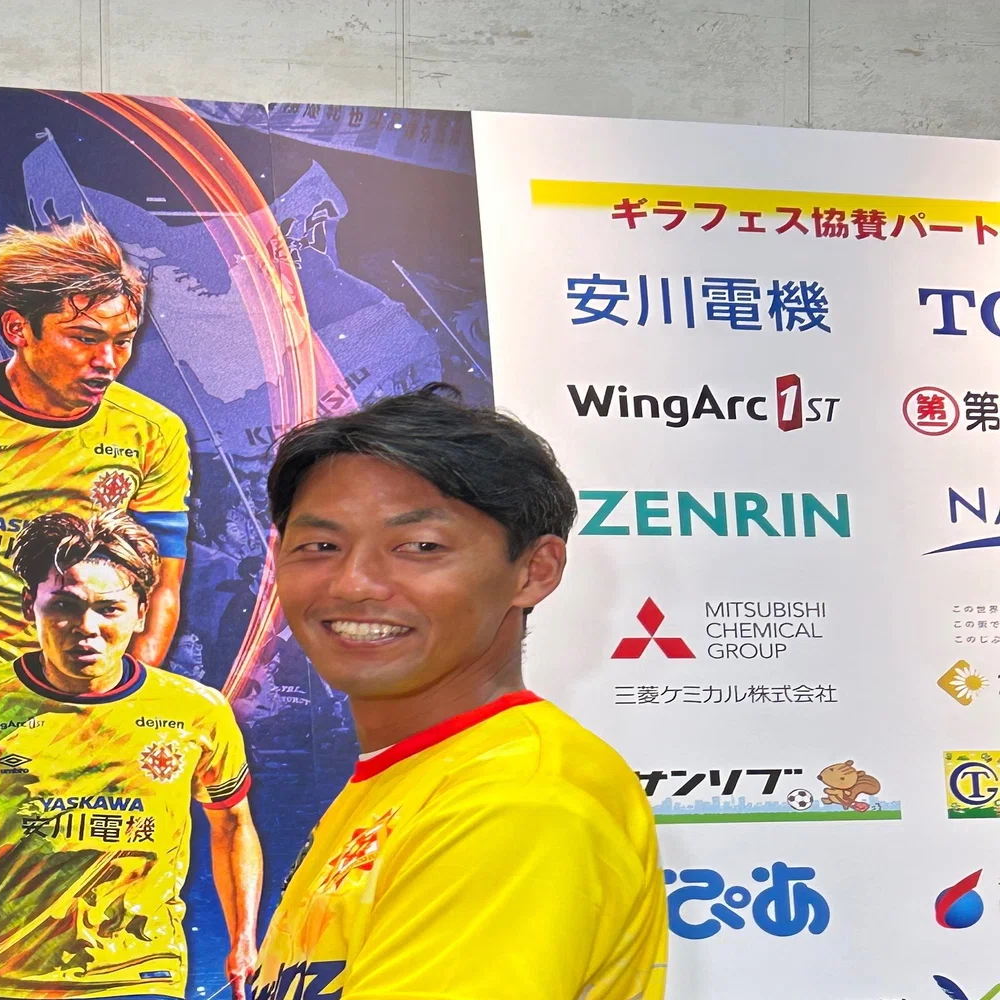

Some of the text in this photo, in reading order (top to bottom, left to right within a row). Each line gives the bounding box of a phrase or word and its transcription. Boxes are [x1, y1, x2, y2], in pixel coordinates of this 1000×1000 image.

[611, 198, 998, 245] ギラフェス協賛パート
[567, 274, 831, 333] 安川電機
[577, 491, 851, 538] ZENRIN
[948, 486, 1000, 525] N
[705, 602, 826, 619] MITSUBISHI
[705, 623, 823, 639] CHEMICAL
[707, 643, 788, 660] GROUP
[614, 684, 838, 705] 三菱ケミカル株式会社
[135, 716, 185, 730] dejiren
[42, 795, 145, 813] YASKAWA
[21, 813, 156, 844] 安川電機
